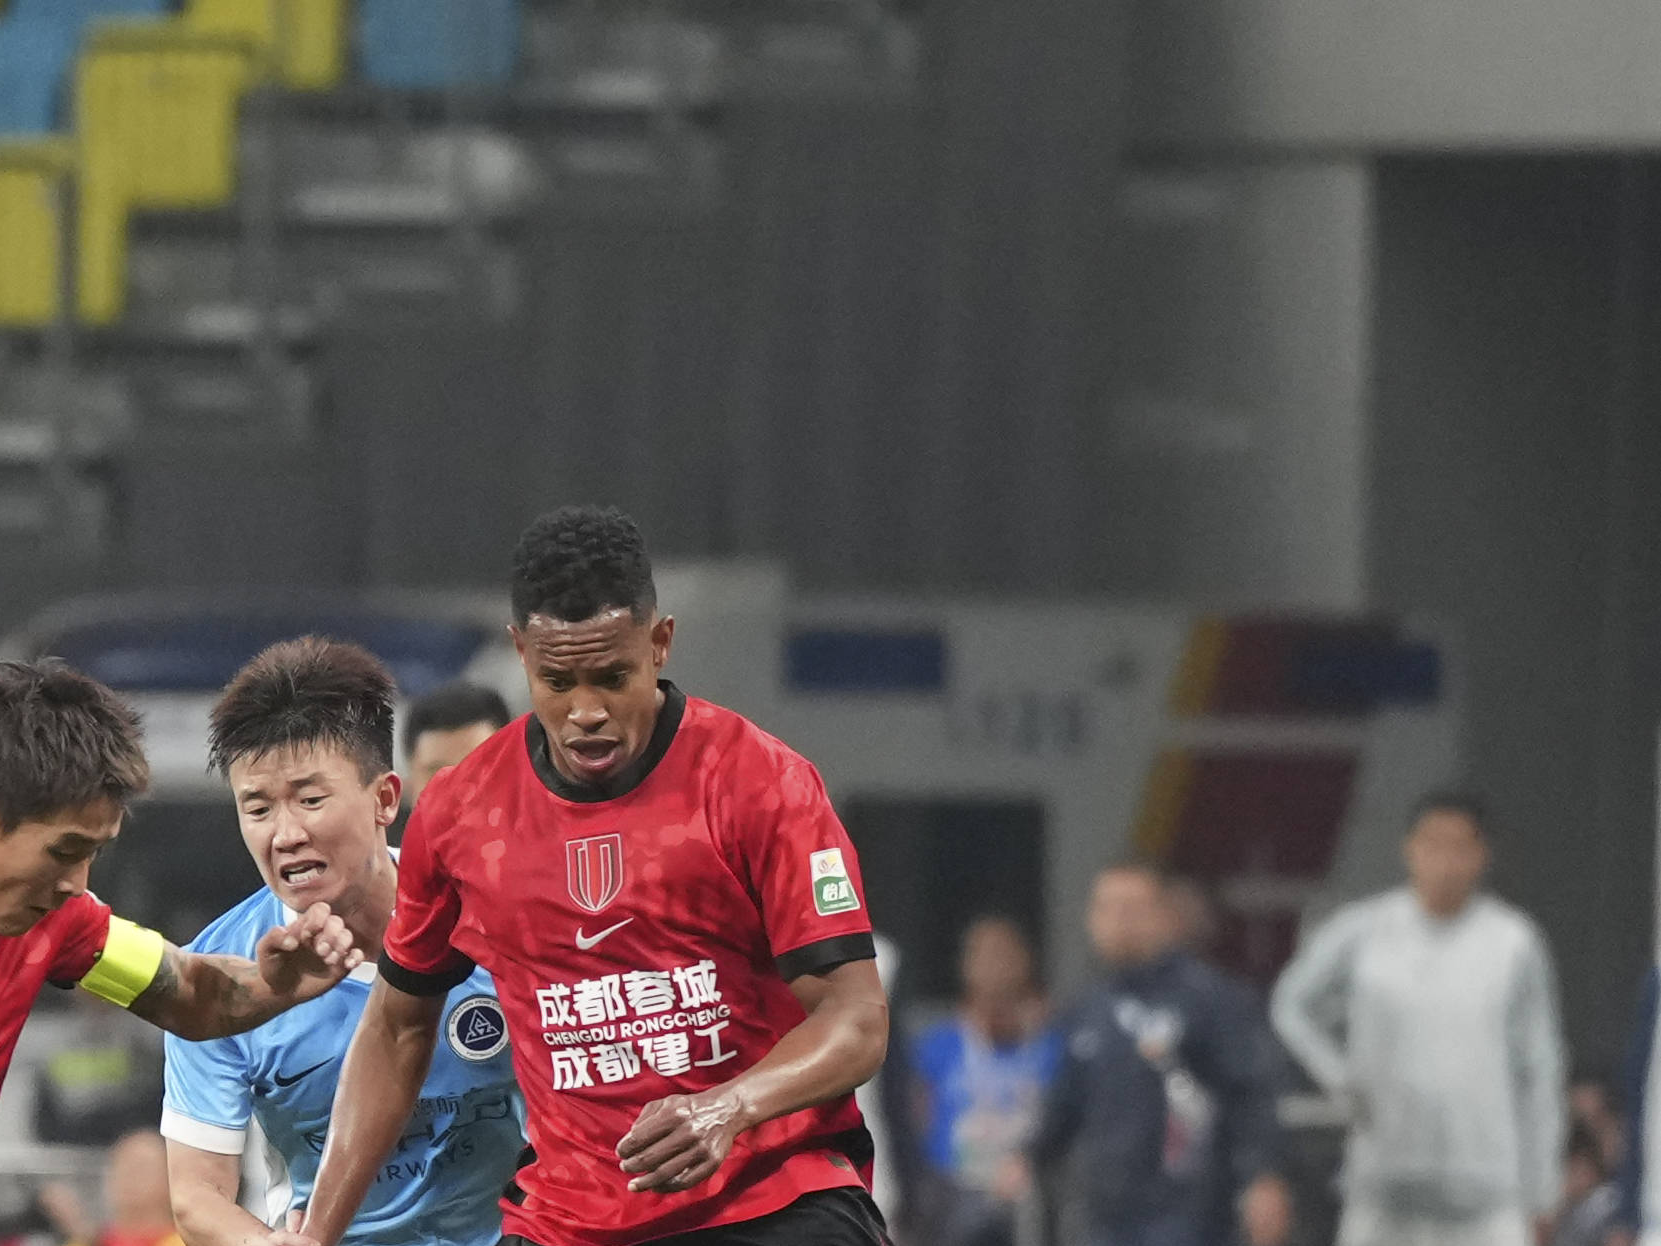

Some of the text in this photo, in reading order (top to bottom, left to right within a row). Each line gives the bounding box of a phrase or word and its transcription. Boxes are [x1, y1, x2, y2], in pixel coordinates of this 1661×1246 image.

[535, 959, 723, 1029] 成都蓉城
[542, 1004, 732, 1046] CHENGDU RONGCHENG
[550, 1019, 738, 1091] 成都建工
